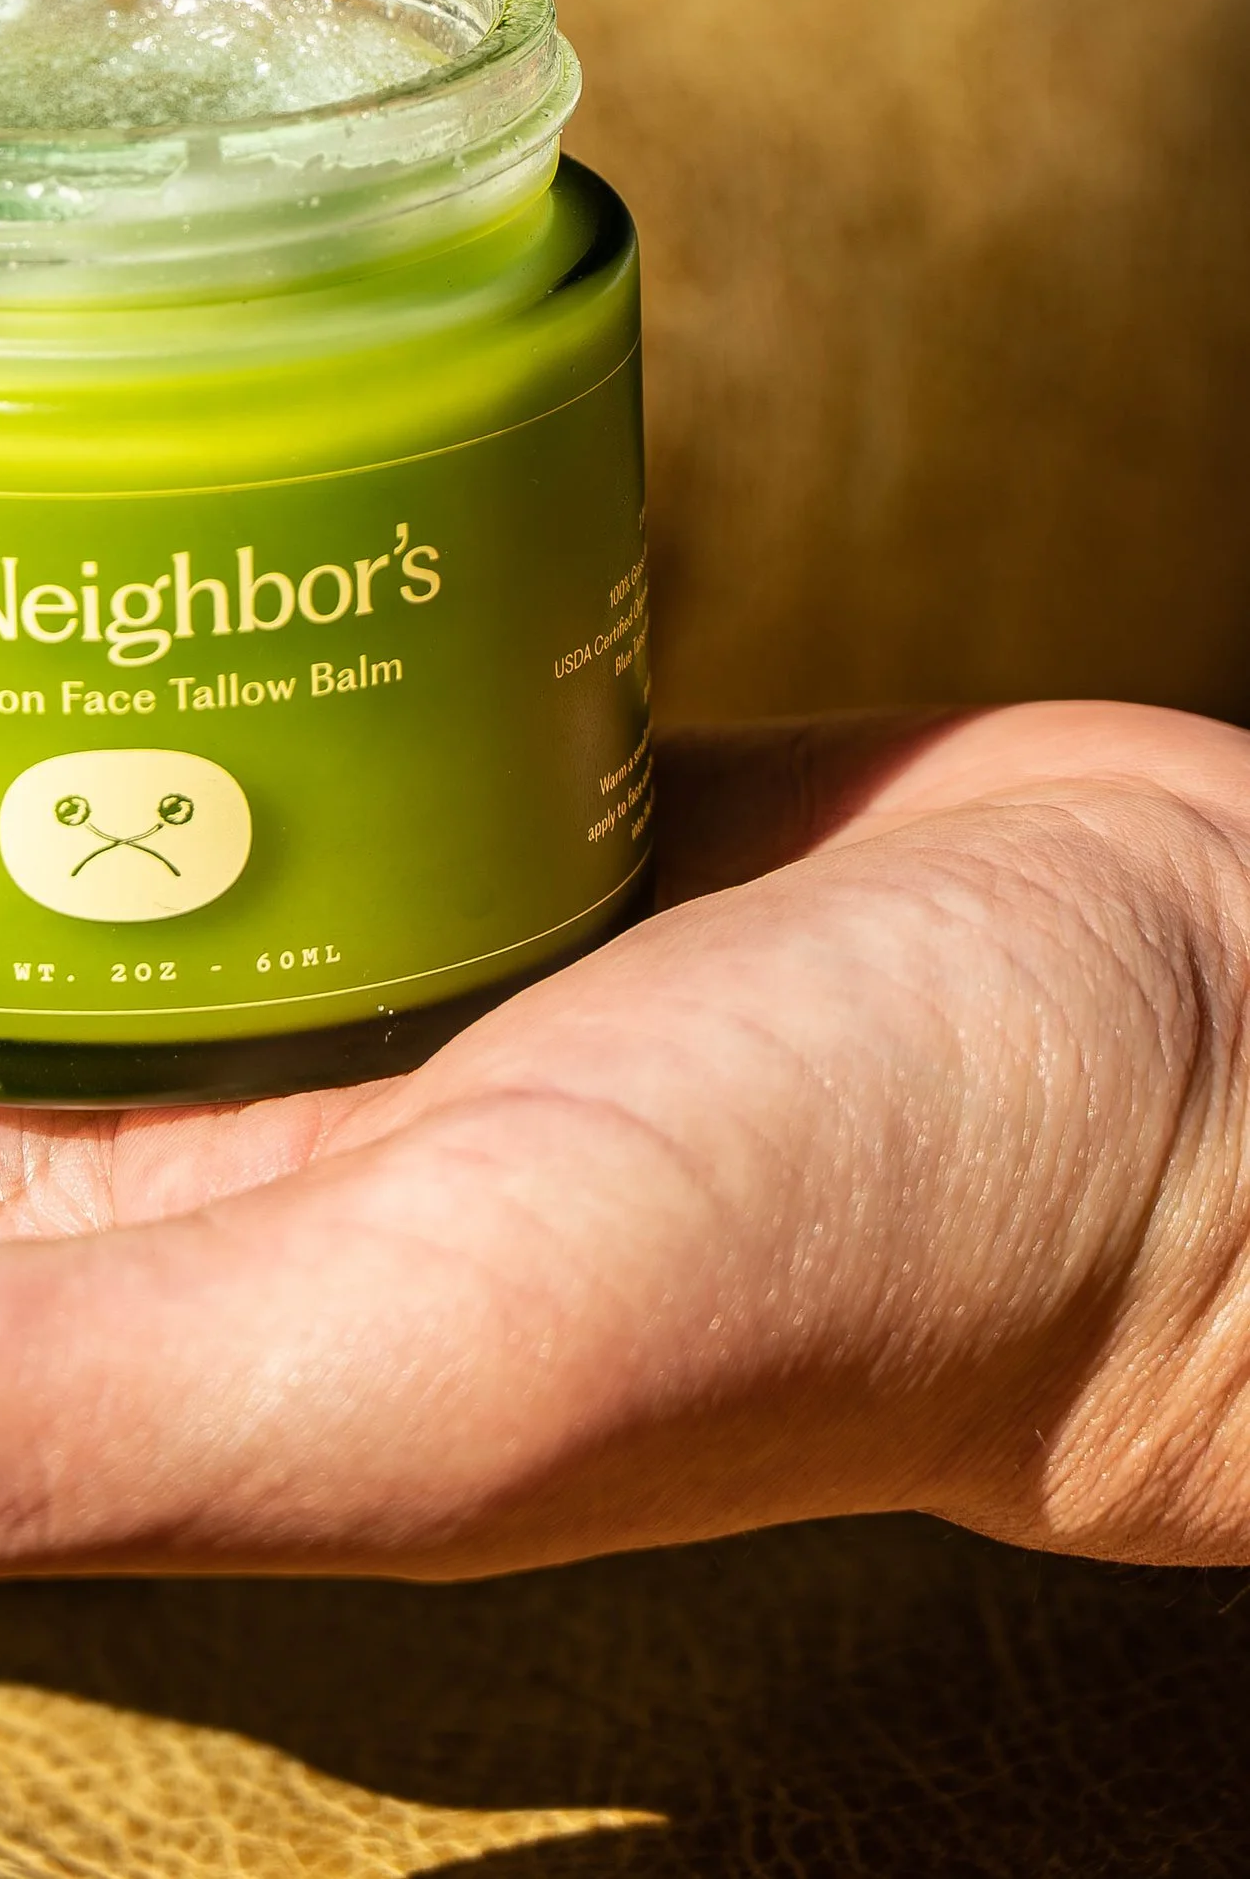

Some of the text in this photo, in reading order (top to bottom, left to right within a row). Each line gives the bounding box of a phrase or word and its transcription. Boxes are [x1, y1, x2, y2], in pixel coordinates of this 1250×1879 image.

[609, 573, 631, 609] 100%
[554, 605, 634, 680] USDA Certified
[62, 680, 155, 714] Face
[169, 672, 297, 712] Tallow
[310, 653, 403, 698] Balm
[615, 650, 633, 677] Blue
[599, 763, 628, 796] Warm
[587, 808, 616, 843] apply
[616, 800, 628, 819] to
[14, 962, 76, 983] WT.
[110, 962, 178, 983] 2OZ
[209, 964, 223, 973] -
[256, 943, 342, 974] 60ML
